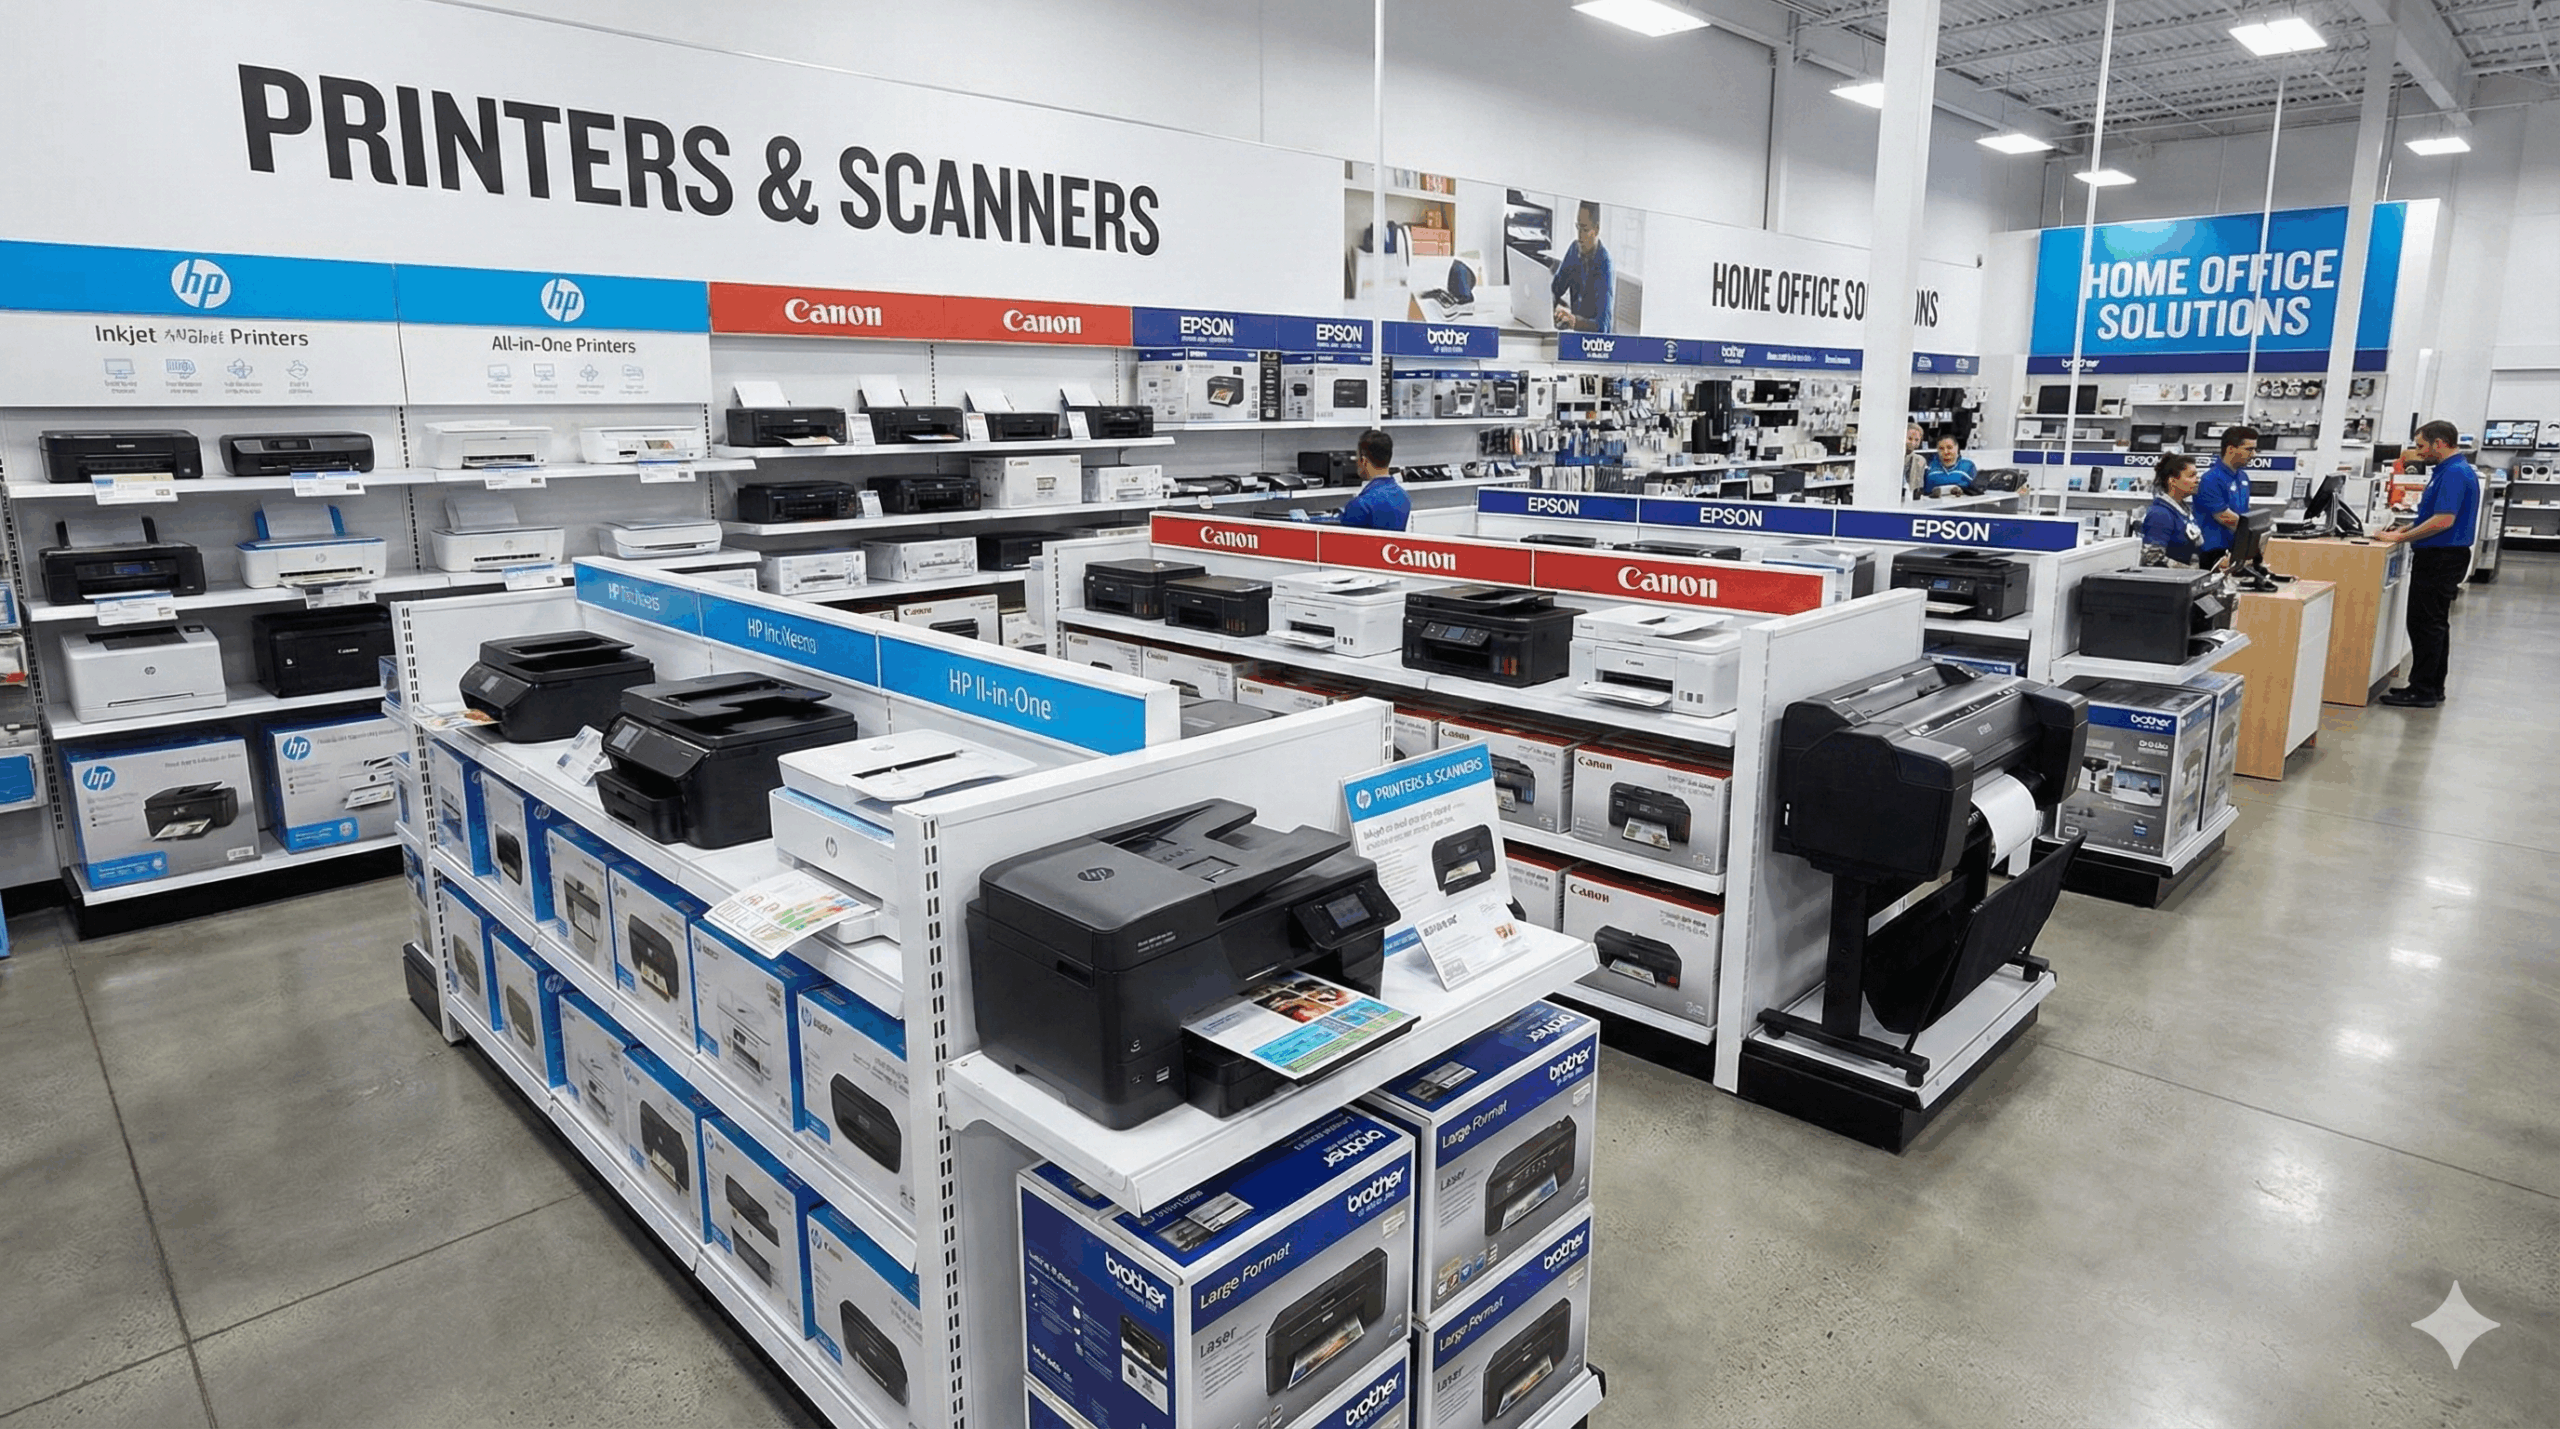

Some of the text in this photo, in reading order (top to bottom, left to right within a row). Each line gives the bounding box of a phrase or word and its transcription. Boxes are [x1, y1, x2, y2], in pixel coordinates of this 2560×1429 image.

[237, 63, 1159, 256] PRINTERS & SCANNERS
[173, 258, 229, 309] hp
[2086, 249, 2338, 299] HOME OFFICE
[543, 278, 584, 323] hp
[1712, 262, 1772, 311] HOME
[1777, 271, 1840, 318] OFFICE
[784, 298, 882, 327] Canon
[1003, 308, 1082, 335] Canon
[1180, 316, 1234, 336] EPSON
[2097, 296, 2311, 340] SOLUTIONS
[95, 325, 157, 346] Inkjet
[231, 328, 309, 346] Printers
[492, 336, 636, 353] All-in-One Printers
[1316, 323, 1362, 342] EPSON
[1427, 328, 1470, 346] brother
[1527, 496, 1580, 515] EPSON
[1700, 507, 1763, 527] EPSON
[1200, 526, 1258, 549] Canon
[1911, 519, 1991, 541] EPSON
[1381, 544, 1457, 570] Canon
[1617, 565, 1718, 600] Canon
[748, 618, 763, 639] HP
[950, 668, 971, 697] HP
[282, 736, 311, 760] hp
[1578, 755, 1613, 771] Canon
[83, 765, 116, 790] hp
[1426, 773, 1434, 786] &
[1550, 1046, 1591, 1081] brother
[1348, 1166, 1405, 1213] brother
[1544, 1230, 1586, 1270] brother
[1105, 1251, 1167, 1308] brother
[1201, 1273, 1239, 1310] Large
[1200, 1325, 1238, 1358] Laser
[1346, 1372, 1400, 1426] brother
